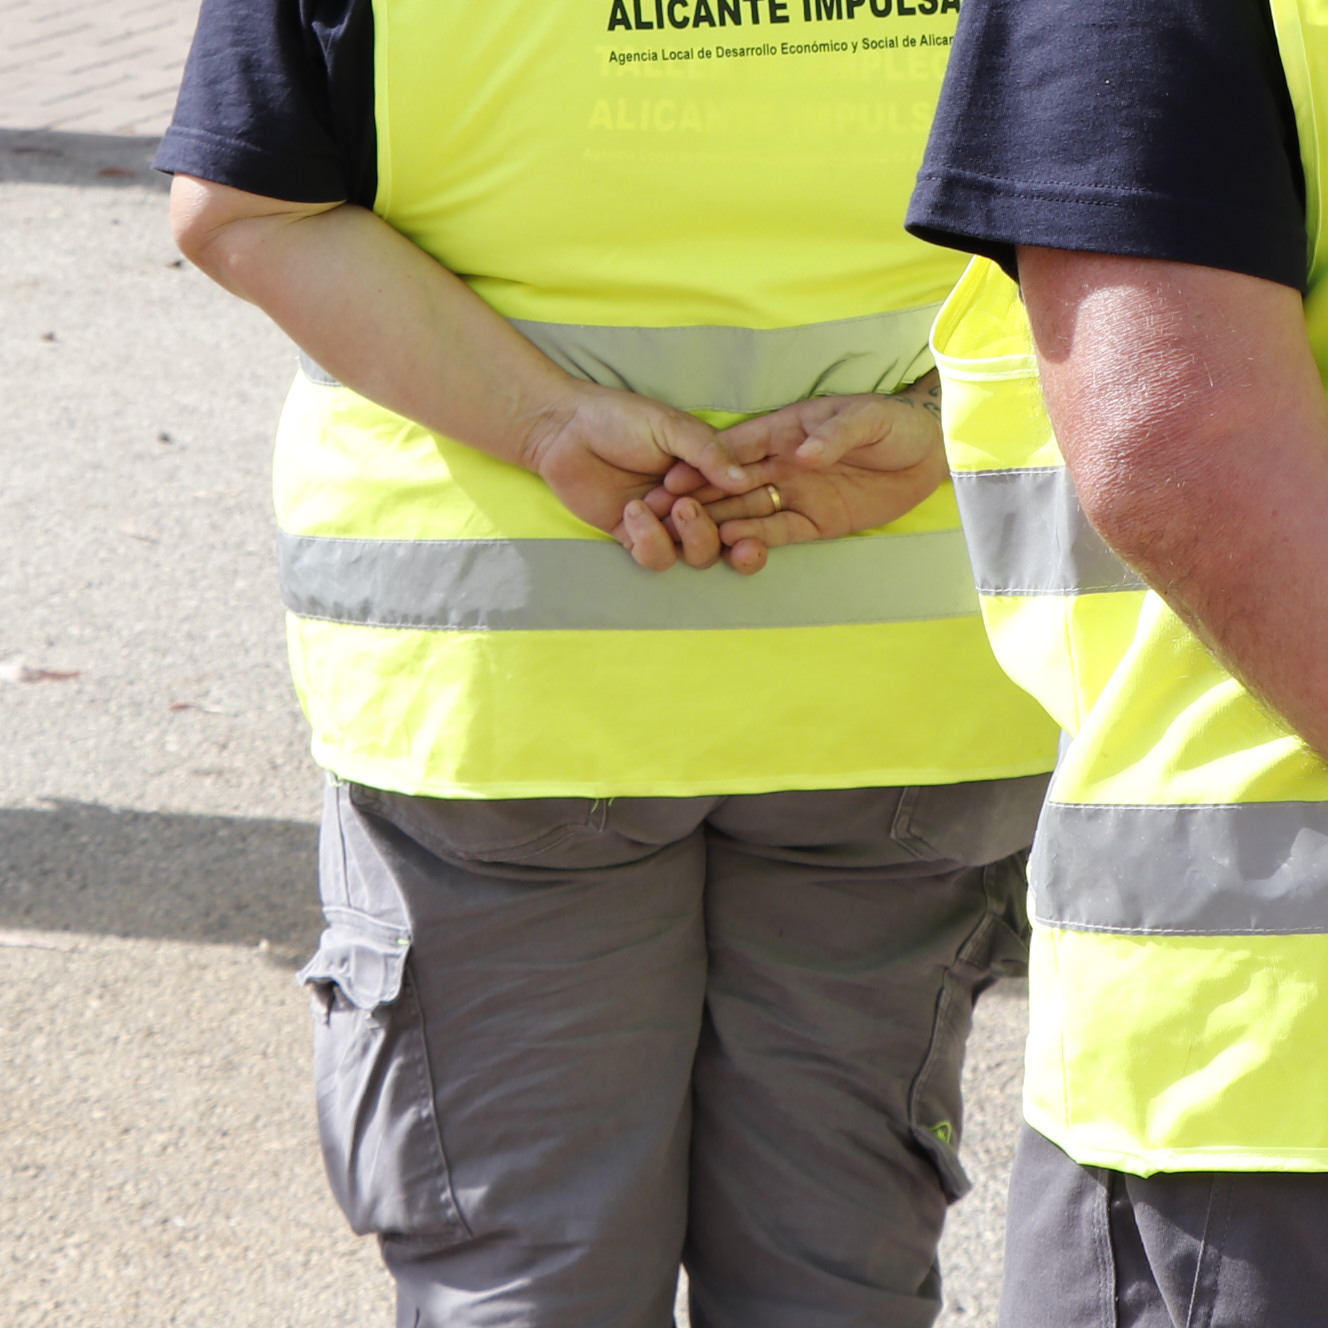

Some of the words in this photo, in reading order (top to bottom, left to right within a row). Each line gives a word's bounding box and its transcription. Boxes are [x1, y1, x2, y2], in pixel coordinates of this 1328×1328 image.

[608, 49, 658, 65] Agencia
[662, 48, 694, 61] Local
[697, 47, 712, 60] de
[716, 43, 777, 58] Desarrollo
[781, 38, 848, 55] Económico
[852, 41, 859, 54] y
[862, 35, 899, 50] Social
[902, 35, 916, 48] de
